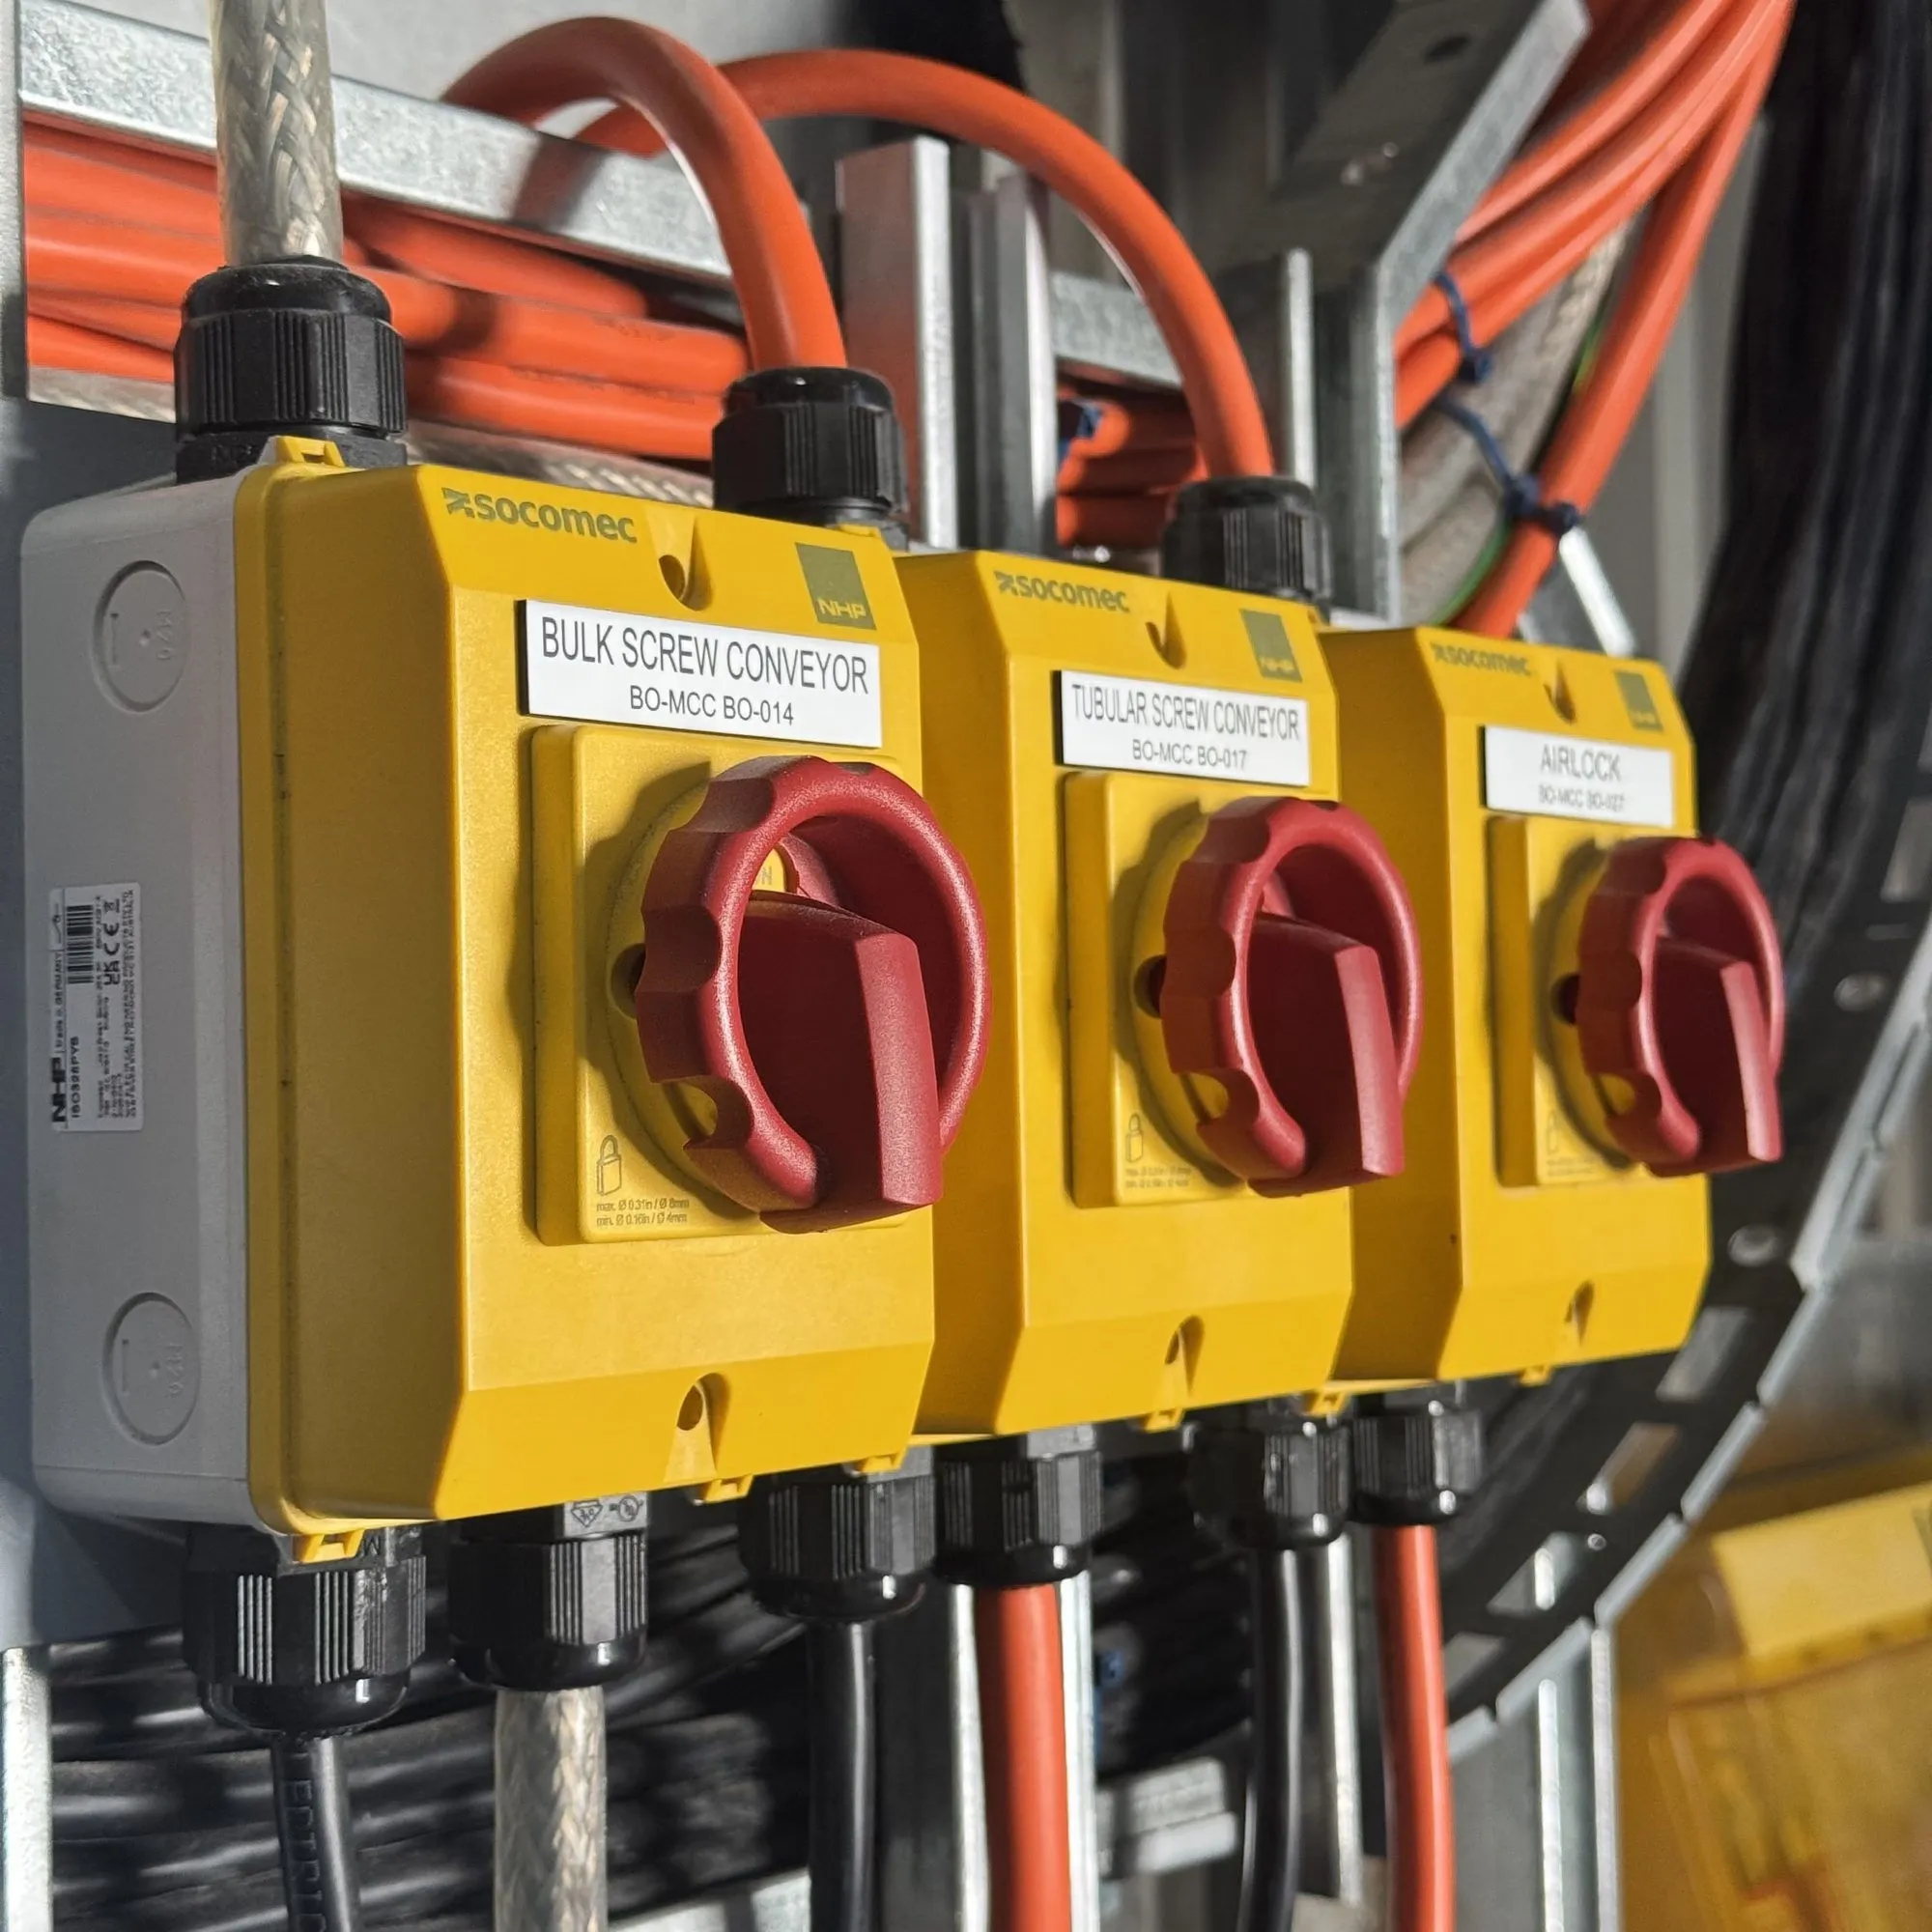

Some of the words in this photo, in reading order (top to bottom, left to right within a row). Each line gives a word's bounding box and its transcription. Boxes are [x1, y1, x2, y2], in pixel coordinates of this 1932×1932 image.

[473, 493, 638, 544] socomec
[816, 597, 867, 619] NHP
[1015, 575, 1131, 614] socomec
[542, 616, 614, 666] BULK
[621, 626, 719, 678] SCREW
[726, 640, 869, 696] CONVEYOR
[629, 684, 717, 718] BO-MCC
[723, 694, 795, 726] BO-014
[1071, 683, 1147, 725] TUBULAR
[1151, 693, 1210, 733] SCREW
[1213, 700, 1300, 742] CONVEYOR
[1132, 738, 1193, 766] BO-MCC
[1197, 745, 1248, 770] BO-017
[1539, 743, 1623, 784] AIRLOCK
[51, 1058, 67, 1122] NHP
